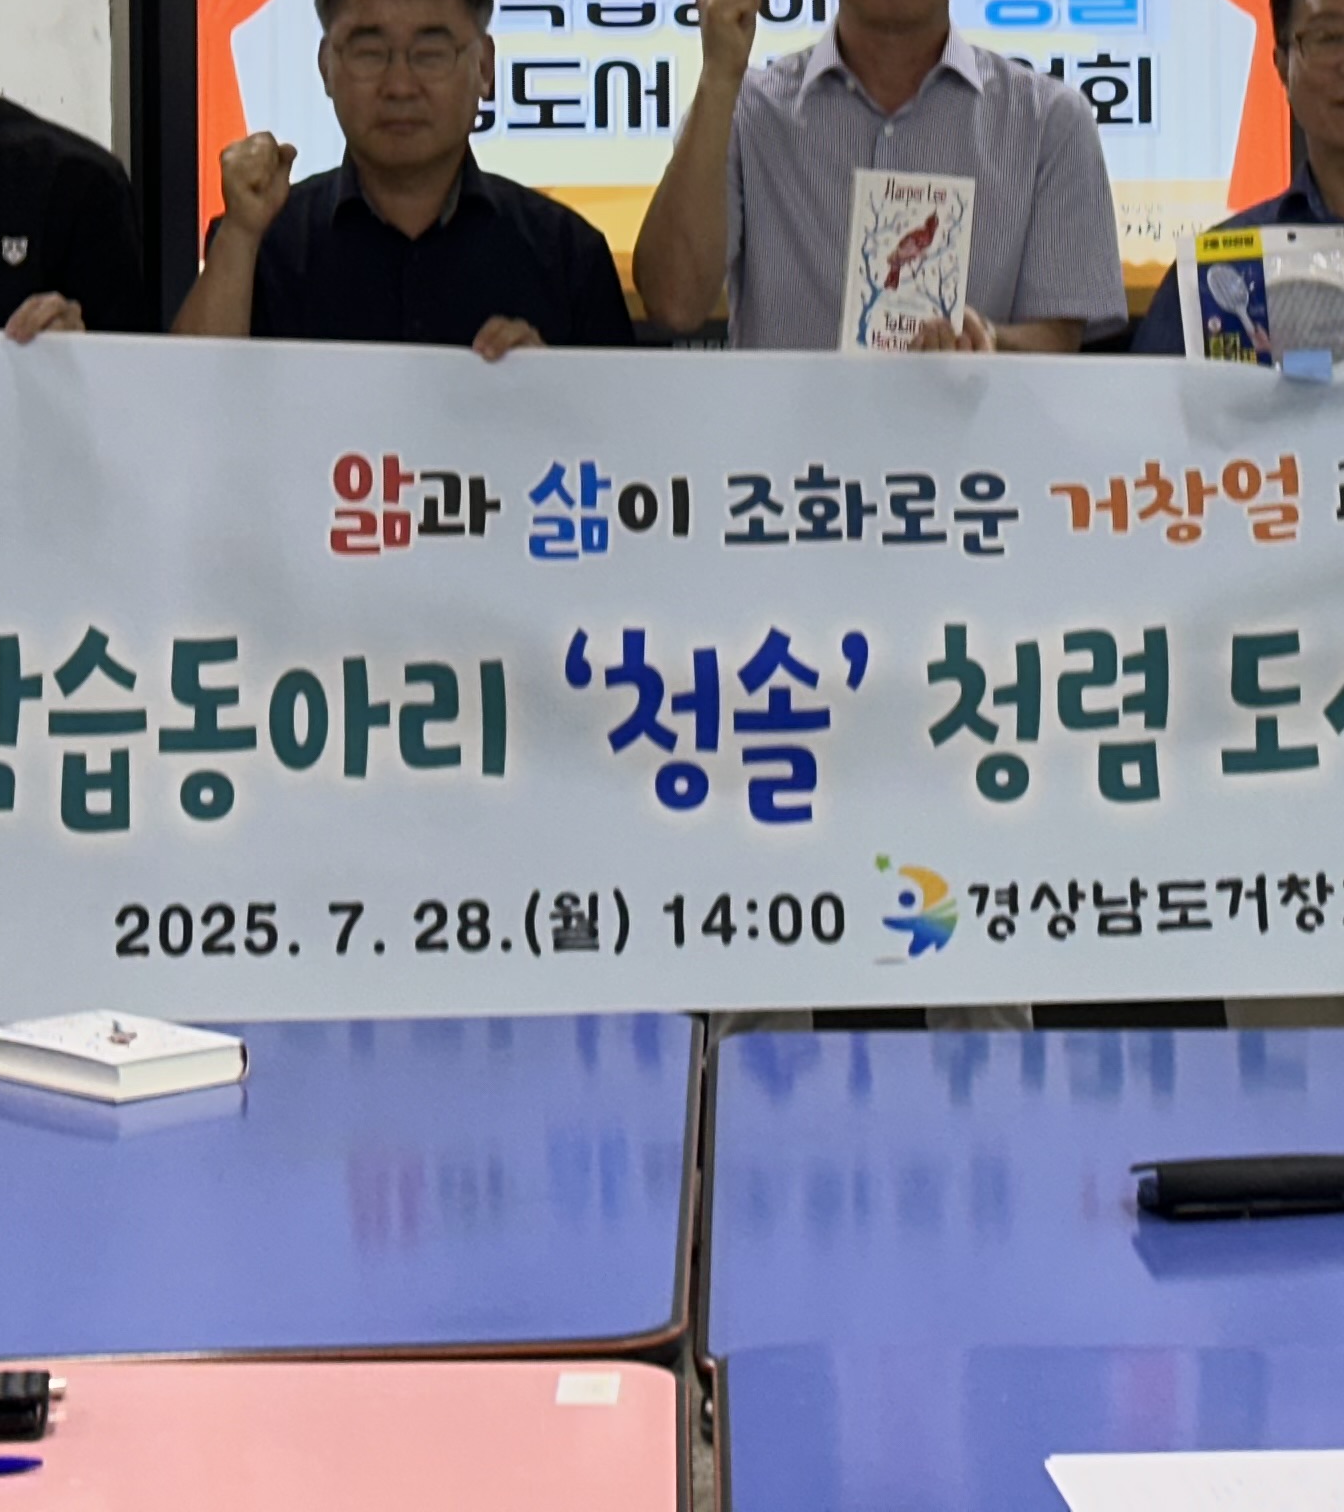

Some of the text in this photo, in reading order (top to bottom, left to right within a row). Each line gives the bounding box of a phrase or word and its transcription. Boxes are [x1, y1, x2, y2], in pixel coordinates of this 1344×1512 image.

[330, 454, 501, 555] 앎과
[529, 461, 689, 559] 삶이
[724, 464, 1019, 555] 조화로운
[1049, 455, 1301, 543] 거창얼
[926, 623, 1170, 803] 청렴
[114, 901, 301, 957] 2025.
[328, 900, 386, 955] 7.
[662, 891, 845, 949] 14:00
